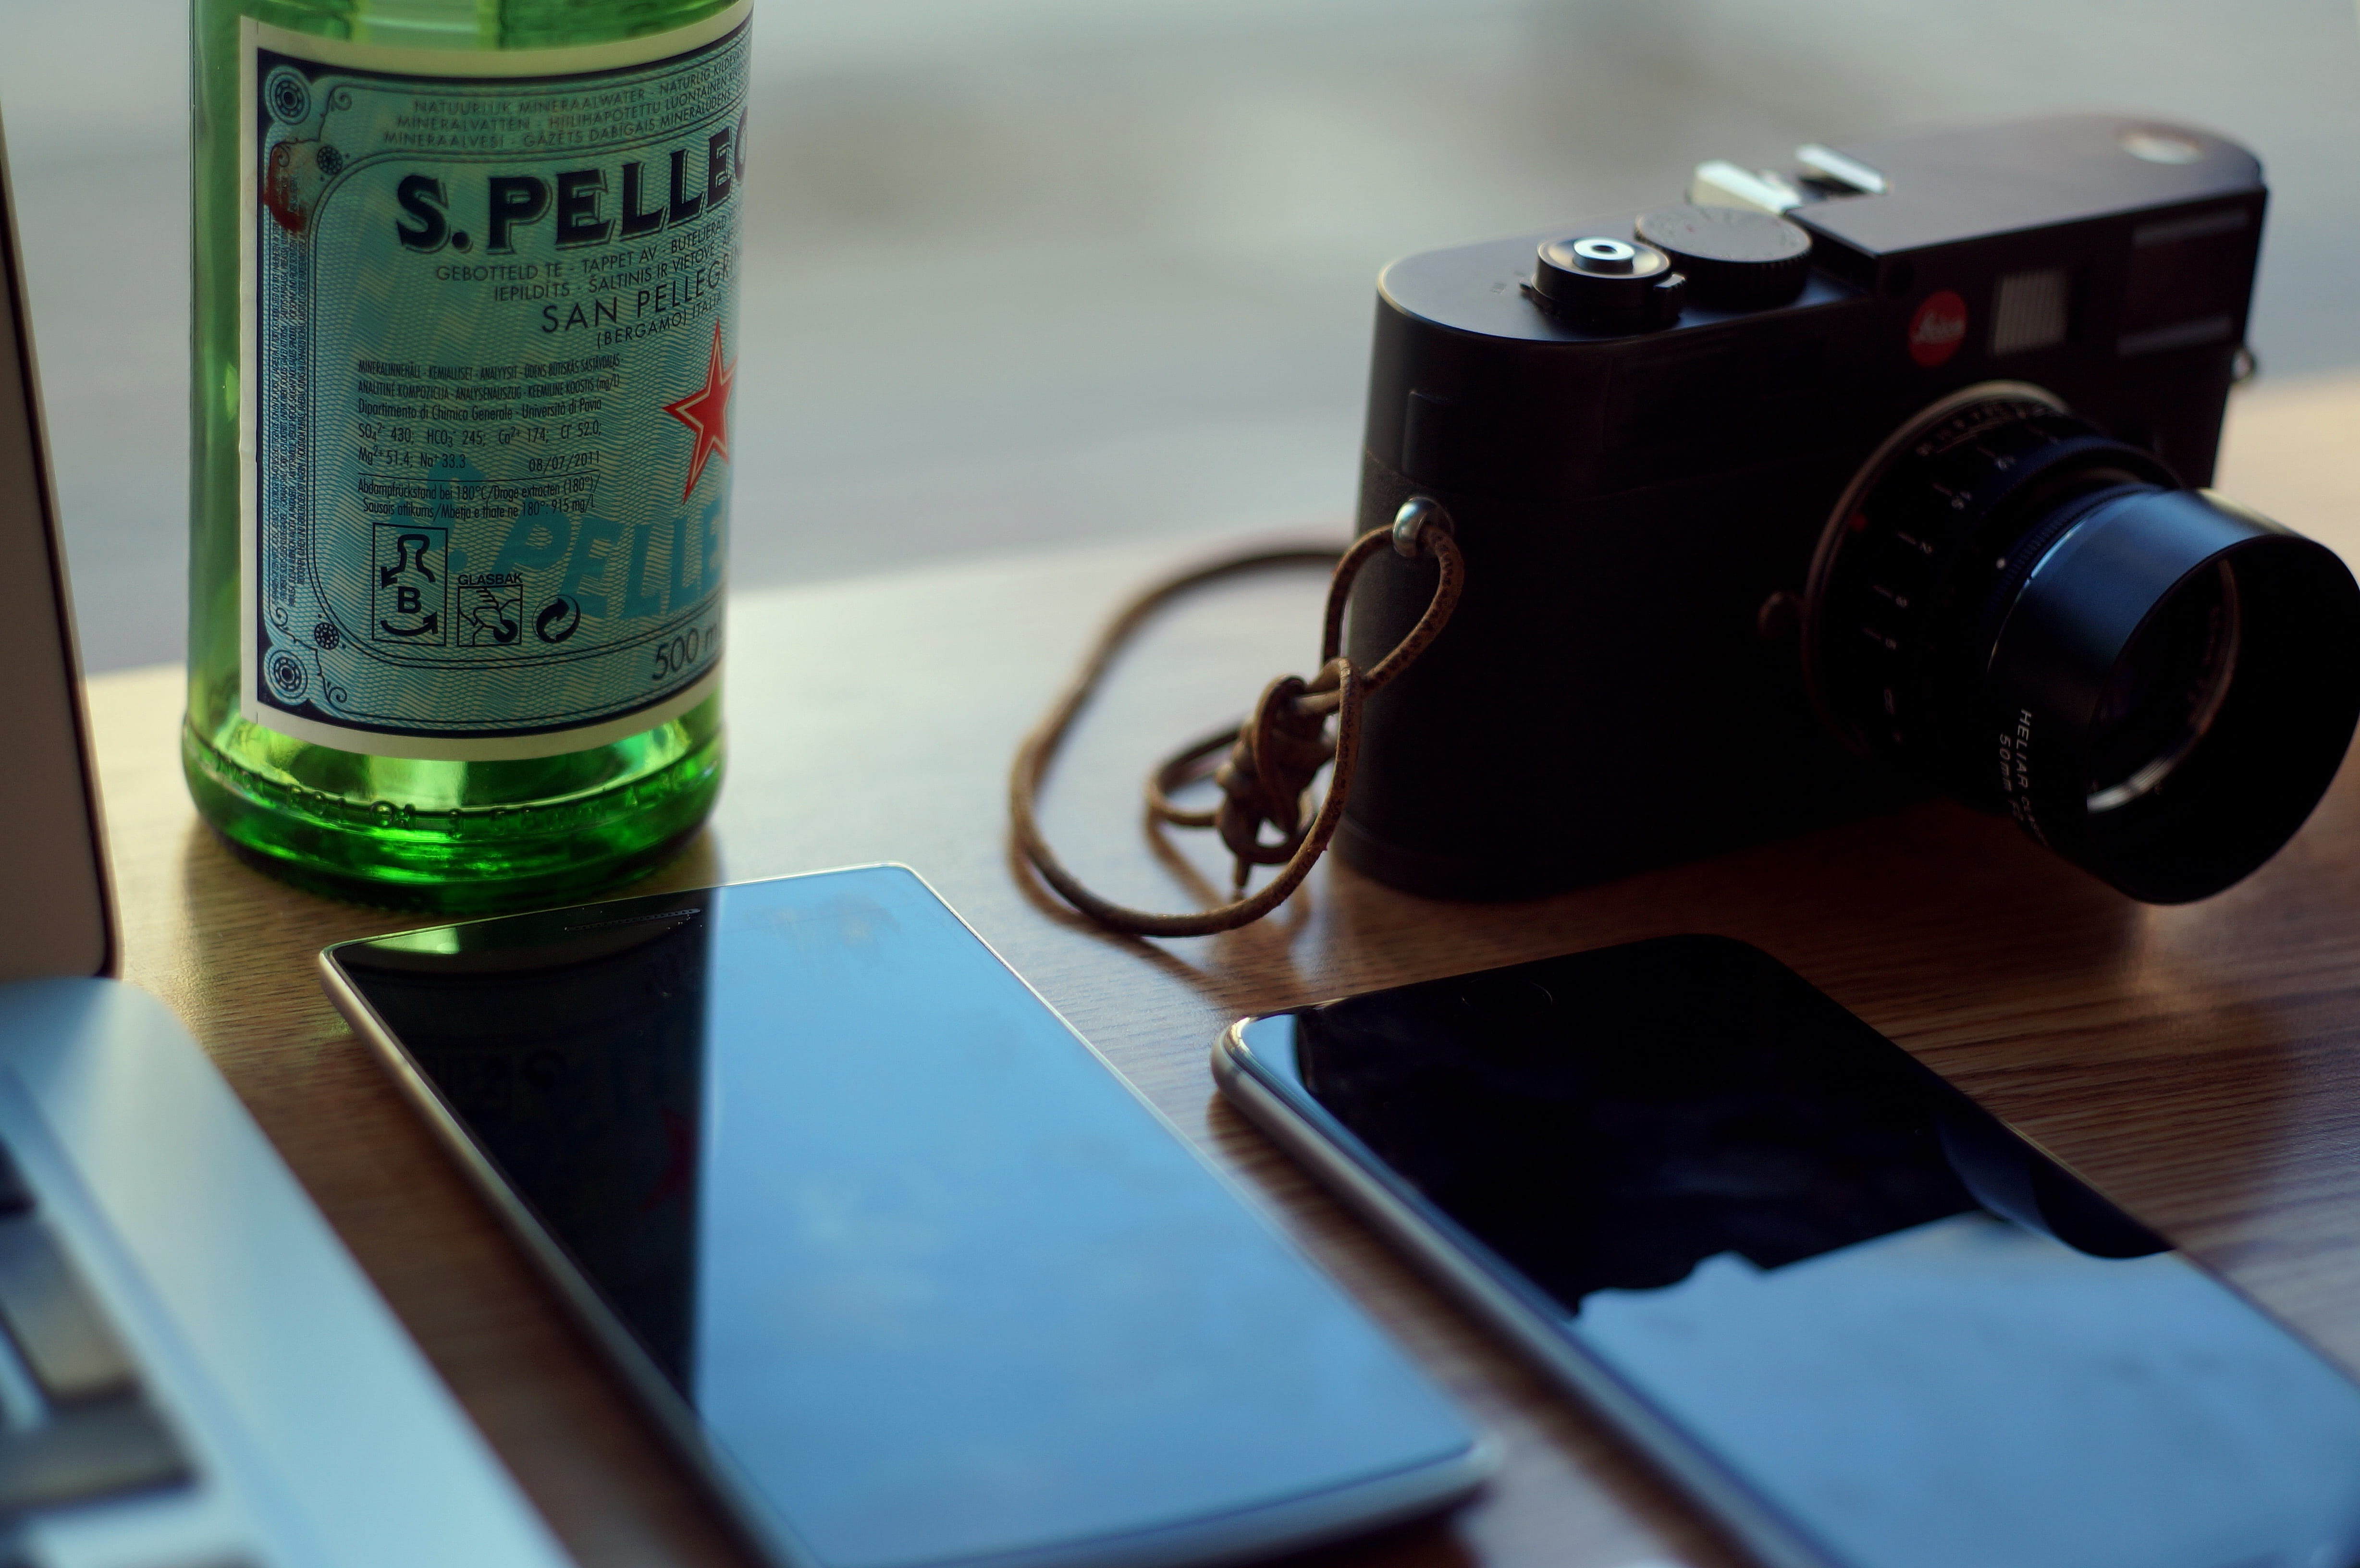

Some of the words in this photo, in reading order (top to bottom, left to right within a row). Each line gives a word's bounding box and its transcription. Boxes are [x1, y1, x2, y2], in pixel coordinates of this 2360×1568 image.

[397, 114, 529, 132] MINERALVATTEN
[665, 74, 727, 112] LUONTAINEN
[519, 89, 644, 113] MINERAALWATER
[660, 68, 711, 97] NATURLIG
[436, 265, 539, 281] GEBOTTELD
[545, 261, 563, 278] TE
[582, 251, 634, 273] TAPPET
[639, 245, 657, 263] AV
[671, 215, 727, 254] BUTELJERAD
[589, 267, 652, 293] ŠALTINIS
[657, 263, 668, 279] IR
[541, 296, 617, 333] SAN
[597, 309, 686, 349] (BERGAMO)
[693, 292, 722, 319] ITALIA
[429, 366, 473, 380] KEMIALLISET
[480, 365, 516, 380] ANALYYSIT
[398, 384, 449, 400] KOMPOZICIJA
[456, 386, 522, 400] ANALYSENAUSZUG
[566, 378, 594, 394] KOOSTIS
[359, 398, 417, 417] Dipartimento
[420, 403, 429, 419] di
[432, 404, 468, 420] Chimica
[471, 404, 513, 421] Generale
[569, 398, 577, 415] di
[580, 397, 602, 412] Pavia
[391, 427, 414, 445] 430;
[462, 430, 486, 447] 245;
[528, 428, 549, 443] 174;
[577, 420, 602, 437] 52.0;
[387, 450, 413, 468] 51.4;
[442, 454, 466, 468] 33.3
[529, 450, 600, 474] 08/07/2011
[358, 478, 436, 500] Abdampfrückstand
[440, 484, 453, 500] bei
[522, 483, 560, 498] extracten
[363, 498, 394, 514] Sausais
[474, 510, 479, 518] e
[482, 506, 504, 518] thate
[508, 507, 518, 517] ne
[552, 498, 569, 514] 915
[572, 493, 595, 513] mg/L
[458, 573, 523, 585] GLASBAK
[397, 587, 421, 614] B
[652, 628, 699, 679] 500
[2016, 708, 2032, 789] HELIAR
